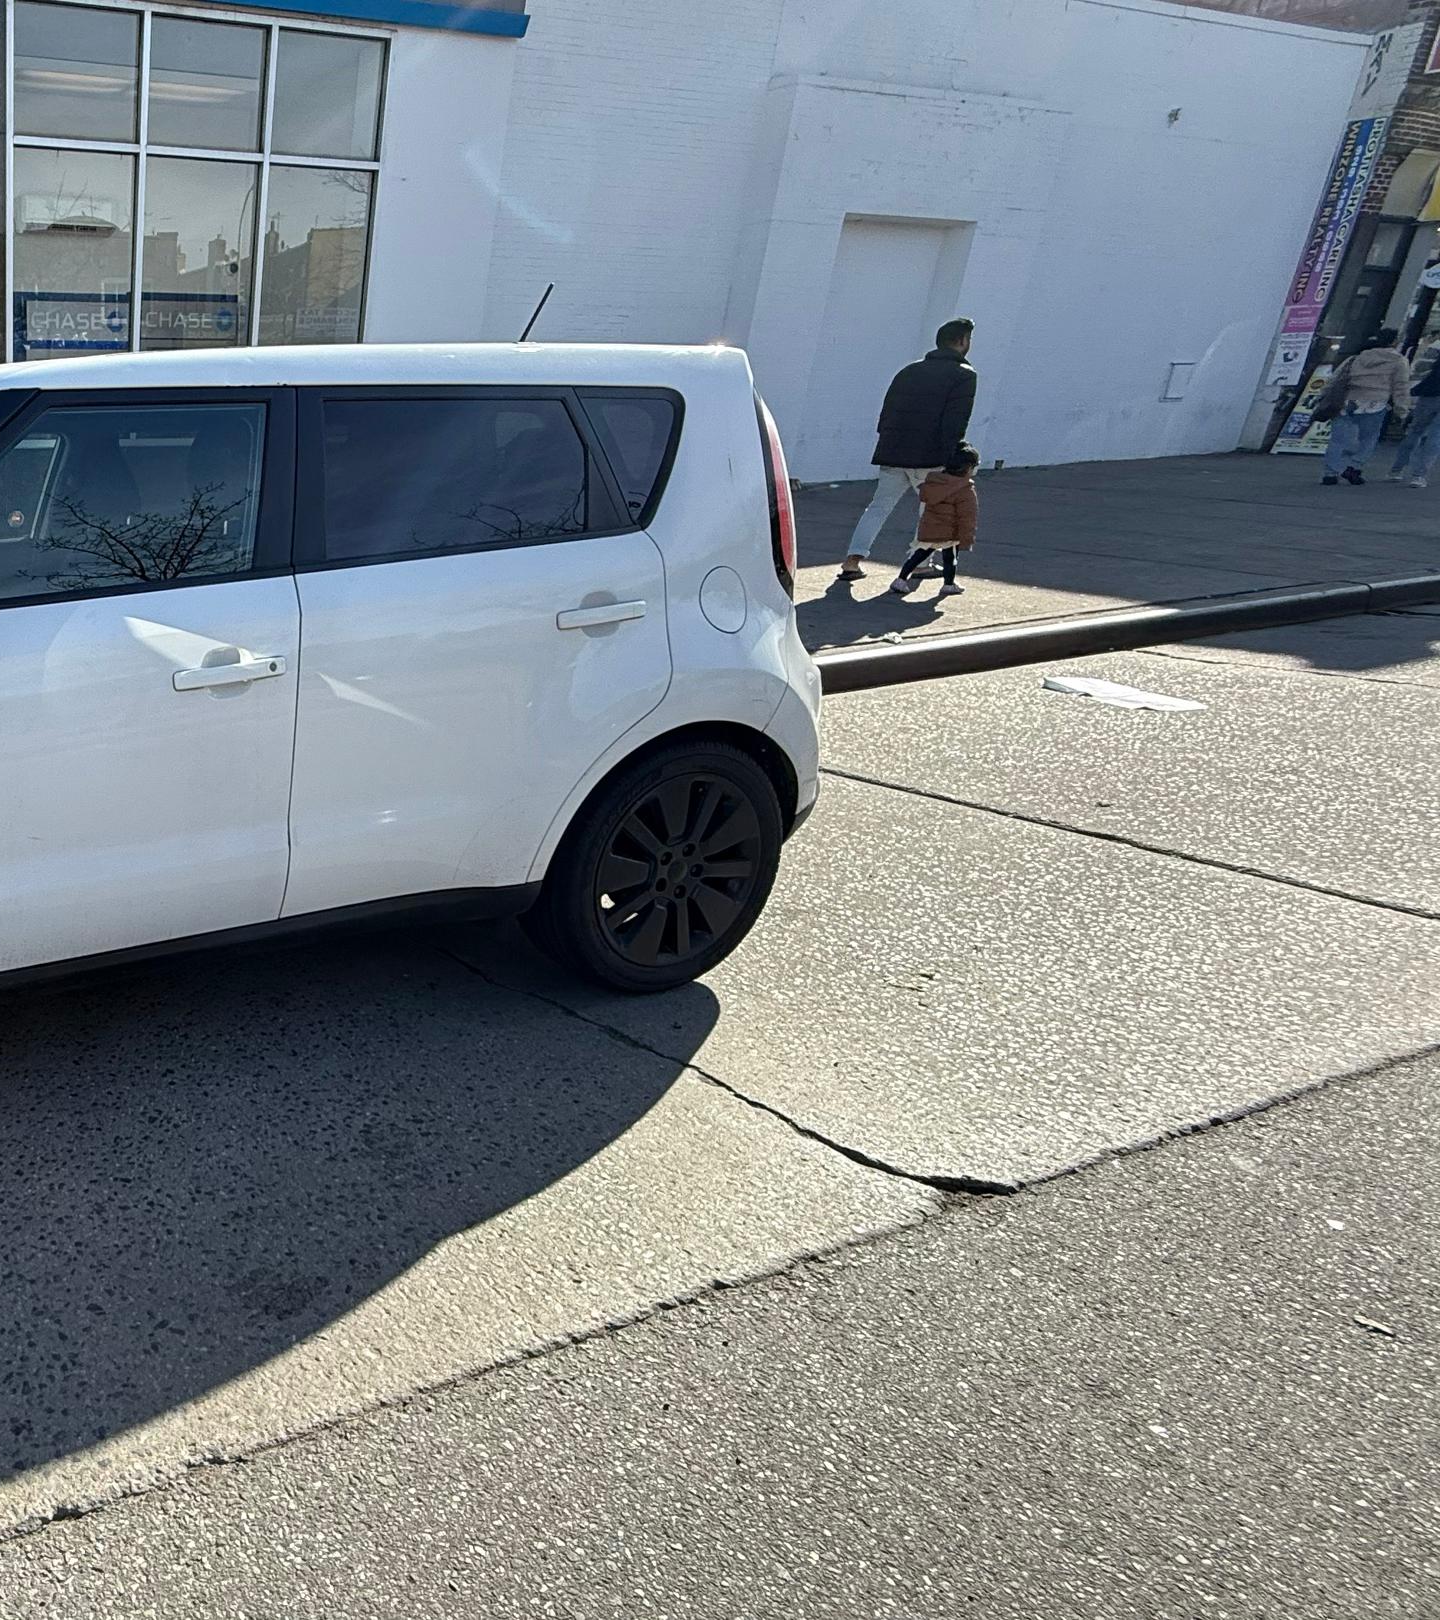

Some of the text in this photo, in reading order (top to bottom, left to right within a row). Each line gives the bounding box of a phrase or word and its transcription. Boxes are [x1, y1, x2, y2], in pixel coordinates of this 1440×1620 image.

[1326, 121, 1362, 202] WINZONE
[1304, 207, 1333, 268] REALTY
[1292, 272, 1310, 304] INC
[1314, 269, 1335, 302] INC
[31, 312, 104, 330] CHASE
[145, 312, 213, 329] CHASE
